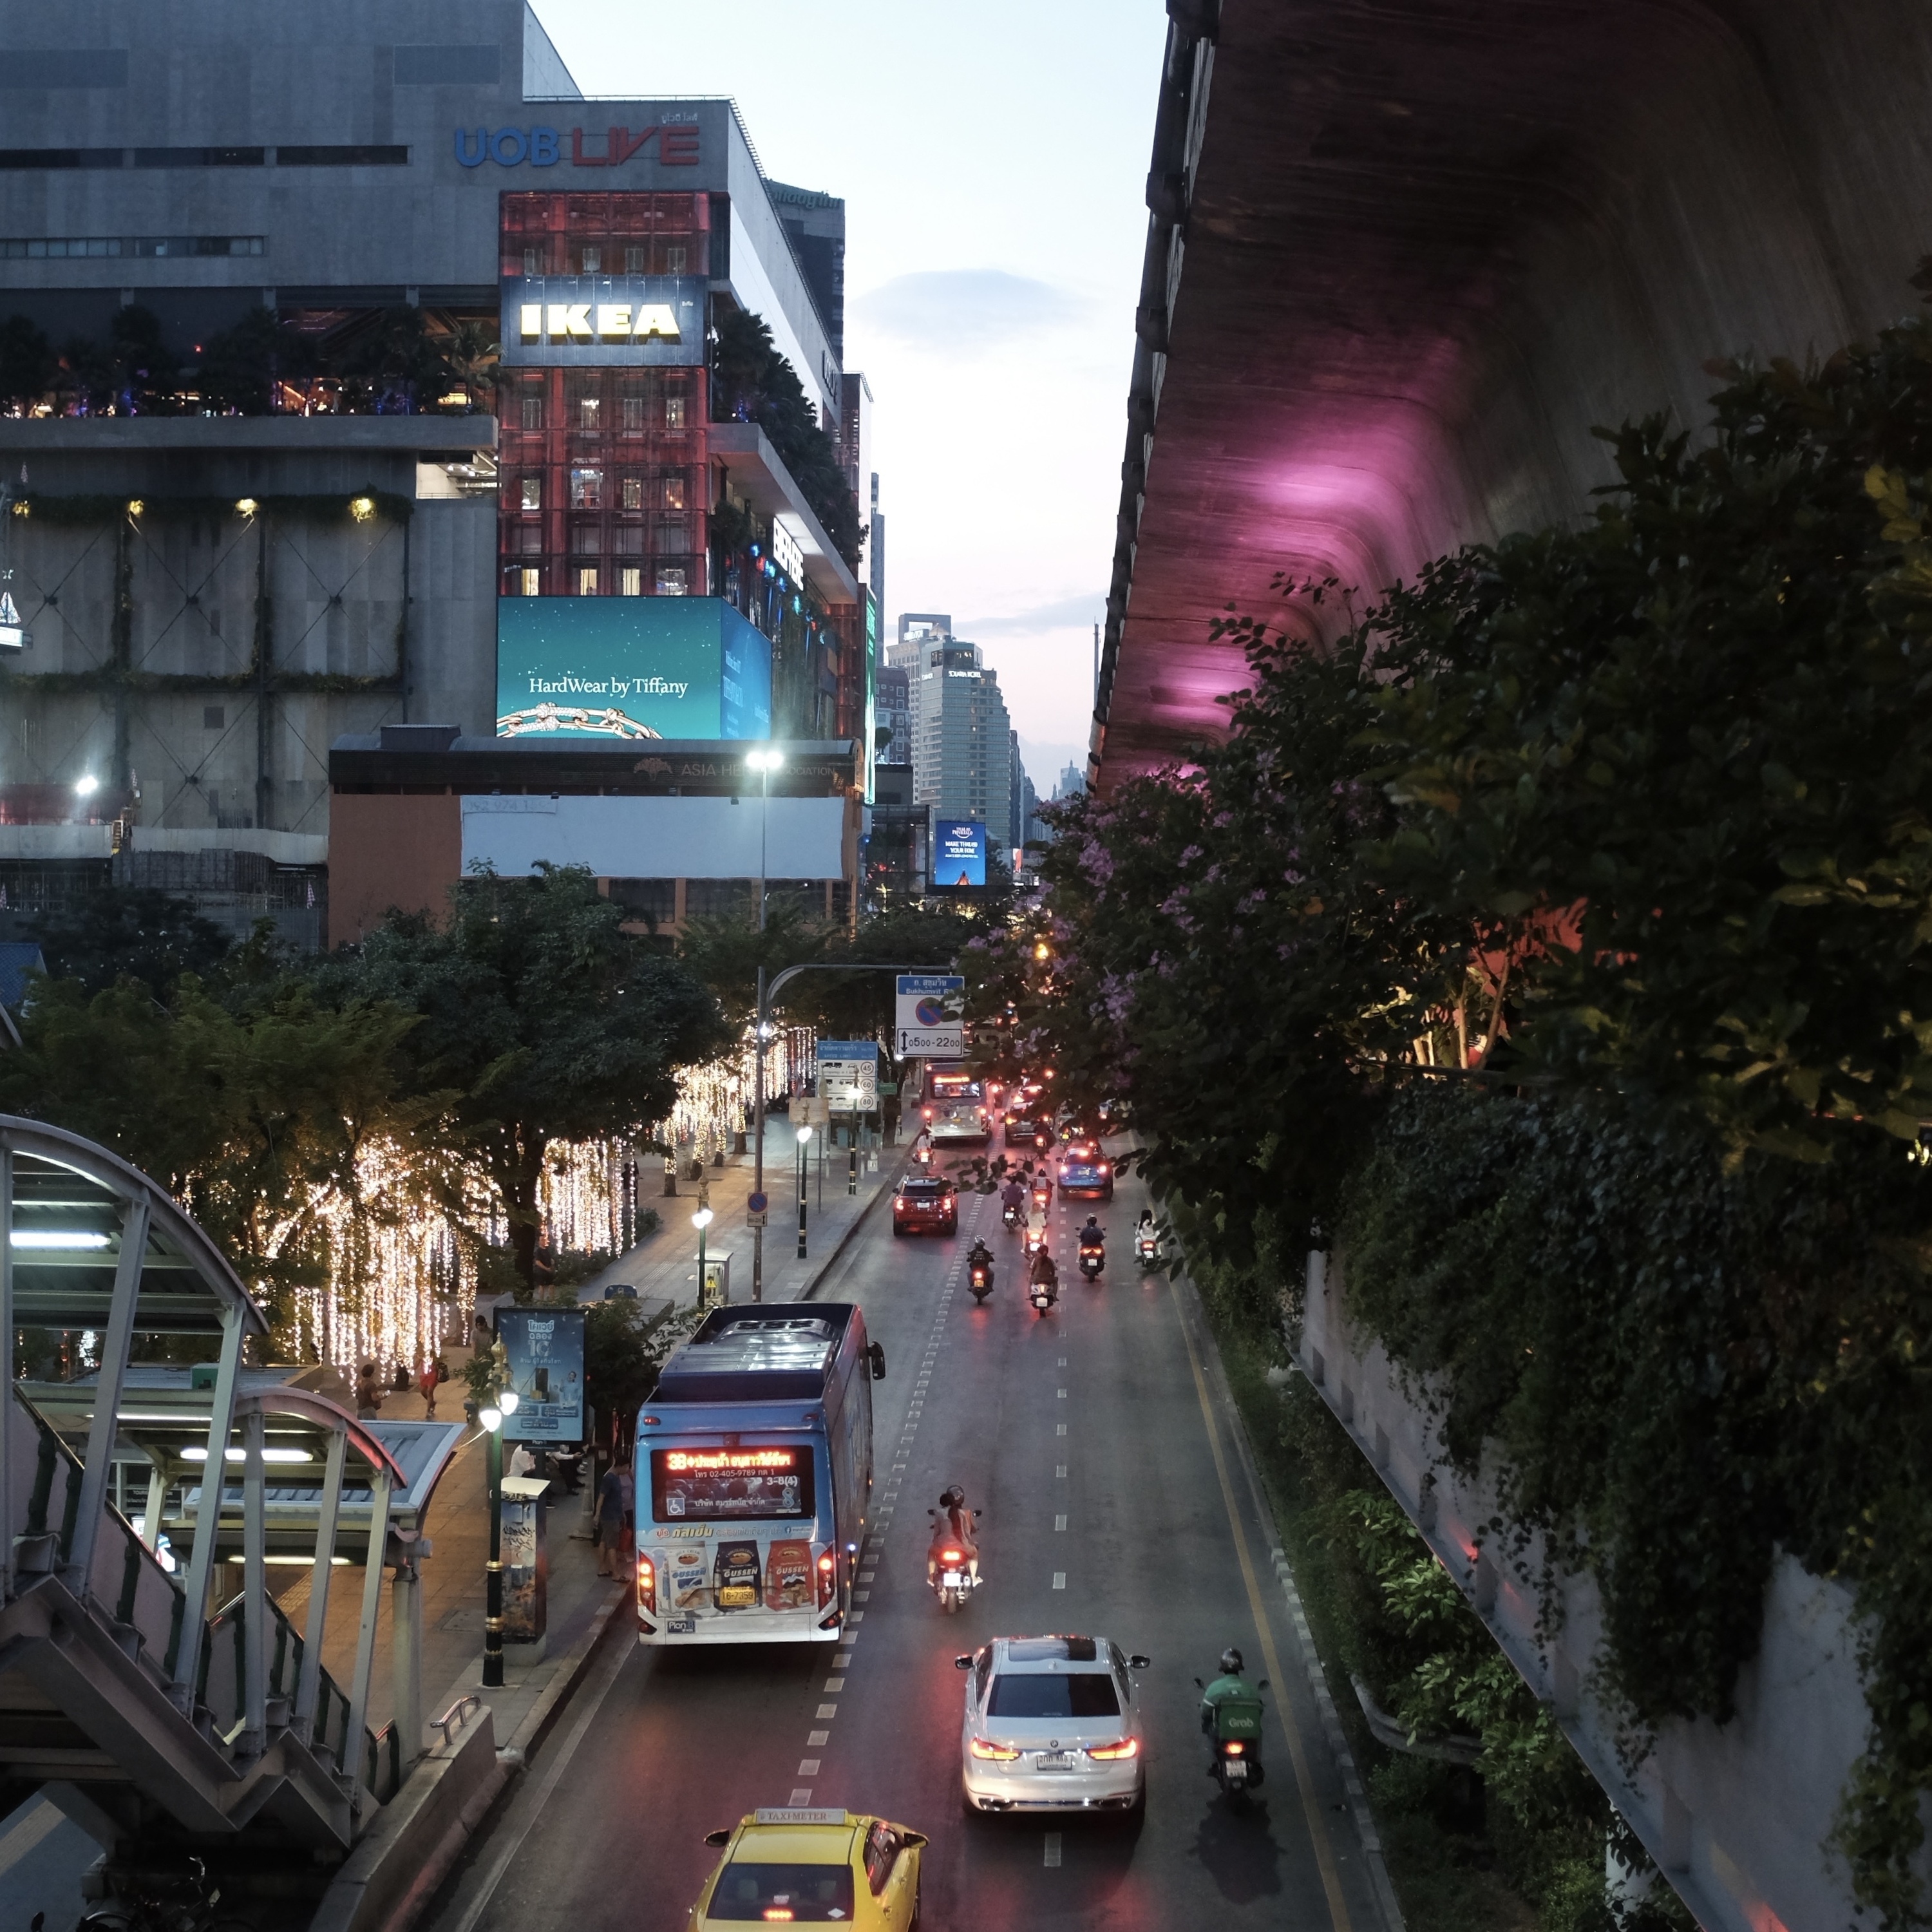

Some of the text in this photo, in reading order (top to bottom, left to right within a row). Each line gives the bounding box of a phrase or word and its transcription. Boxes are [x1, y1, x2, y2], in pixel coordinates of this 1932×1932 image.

[455, 126, 699, 167] UOB LIVE
[520, 304, 681, 335] IKEA
[529, 677, 688, 699] HardWear by Tiffany
[681, 764, 716, 777] ASIA
[923, 978, 947, 989] สุขุมวิท
[709, 1469, 755, 1478] 02-405-9789
[766, 1475, 798, 1487] 3-8(4)
[672, 1567, 706, 1578] GUSSEN
[724, 1567, 758, 1578] GUSSEN
[776, 1566, 809, 1575] GUSSEN
[1229, 1718, 1254, 1728] Grab
